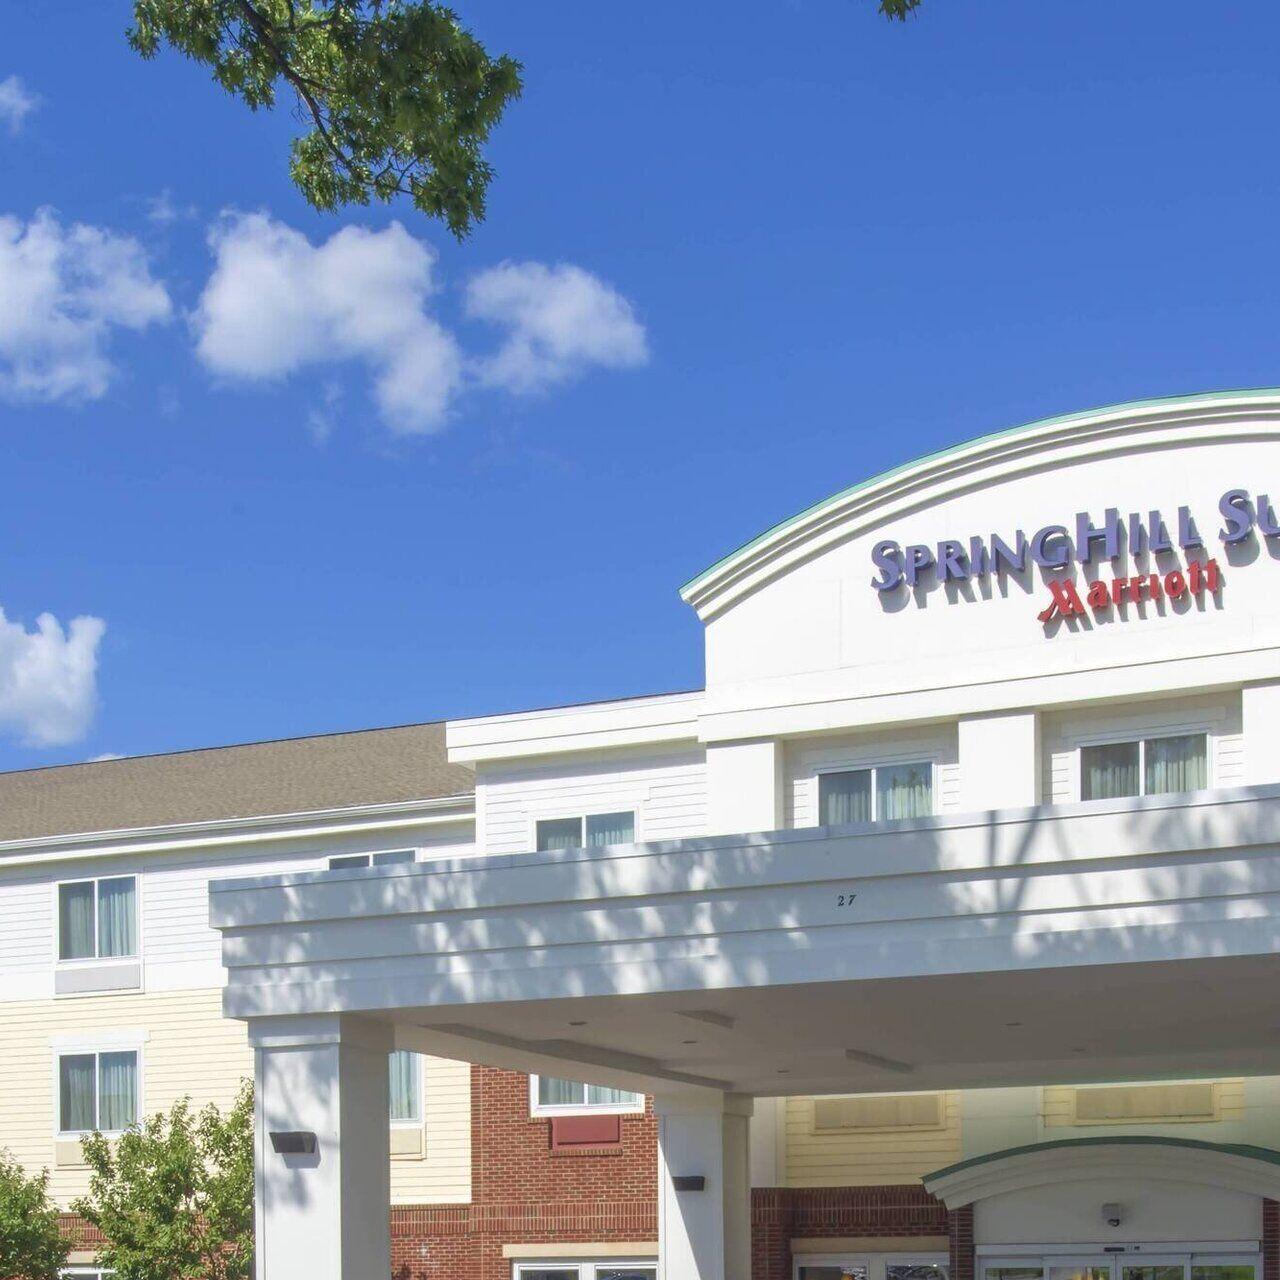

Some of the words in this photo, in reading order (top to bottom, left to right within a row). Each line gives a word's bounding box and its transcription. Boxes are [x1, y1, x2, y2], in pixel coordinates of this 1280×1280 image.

[870, 505, 1205, 592] SPRINGHILL
[1036, 557, 1222, 624] Marriott
[837, 894, 858, 907] 27
